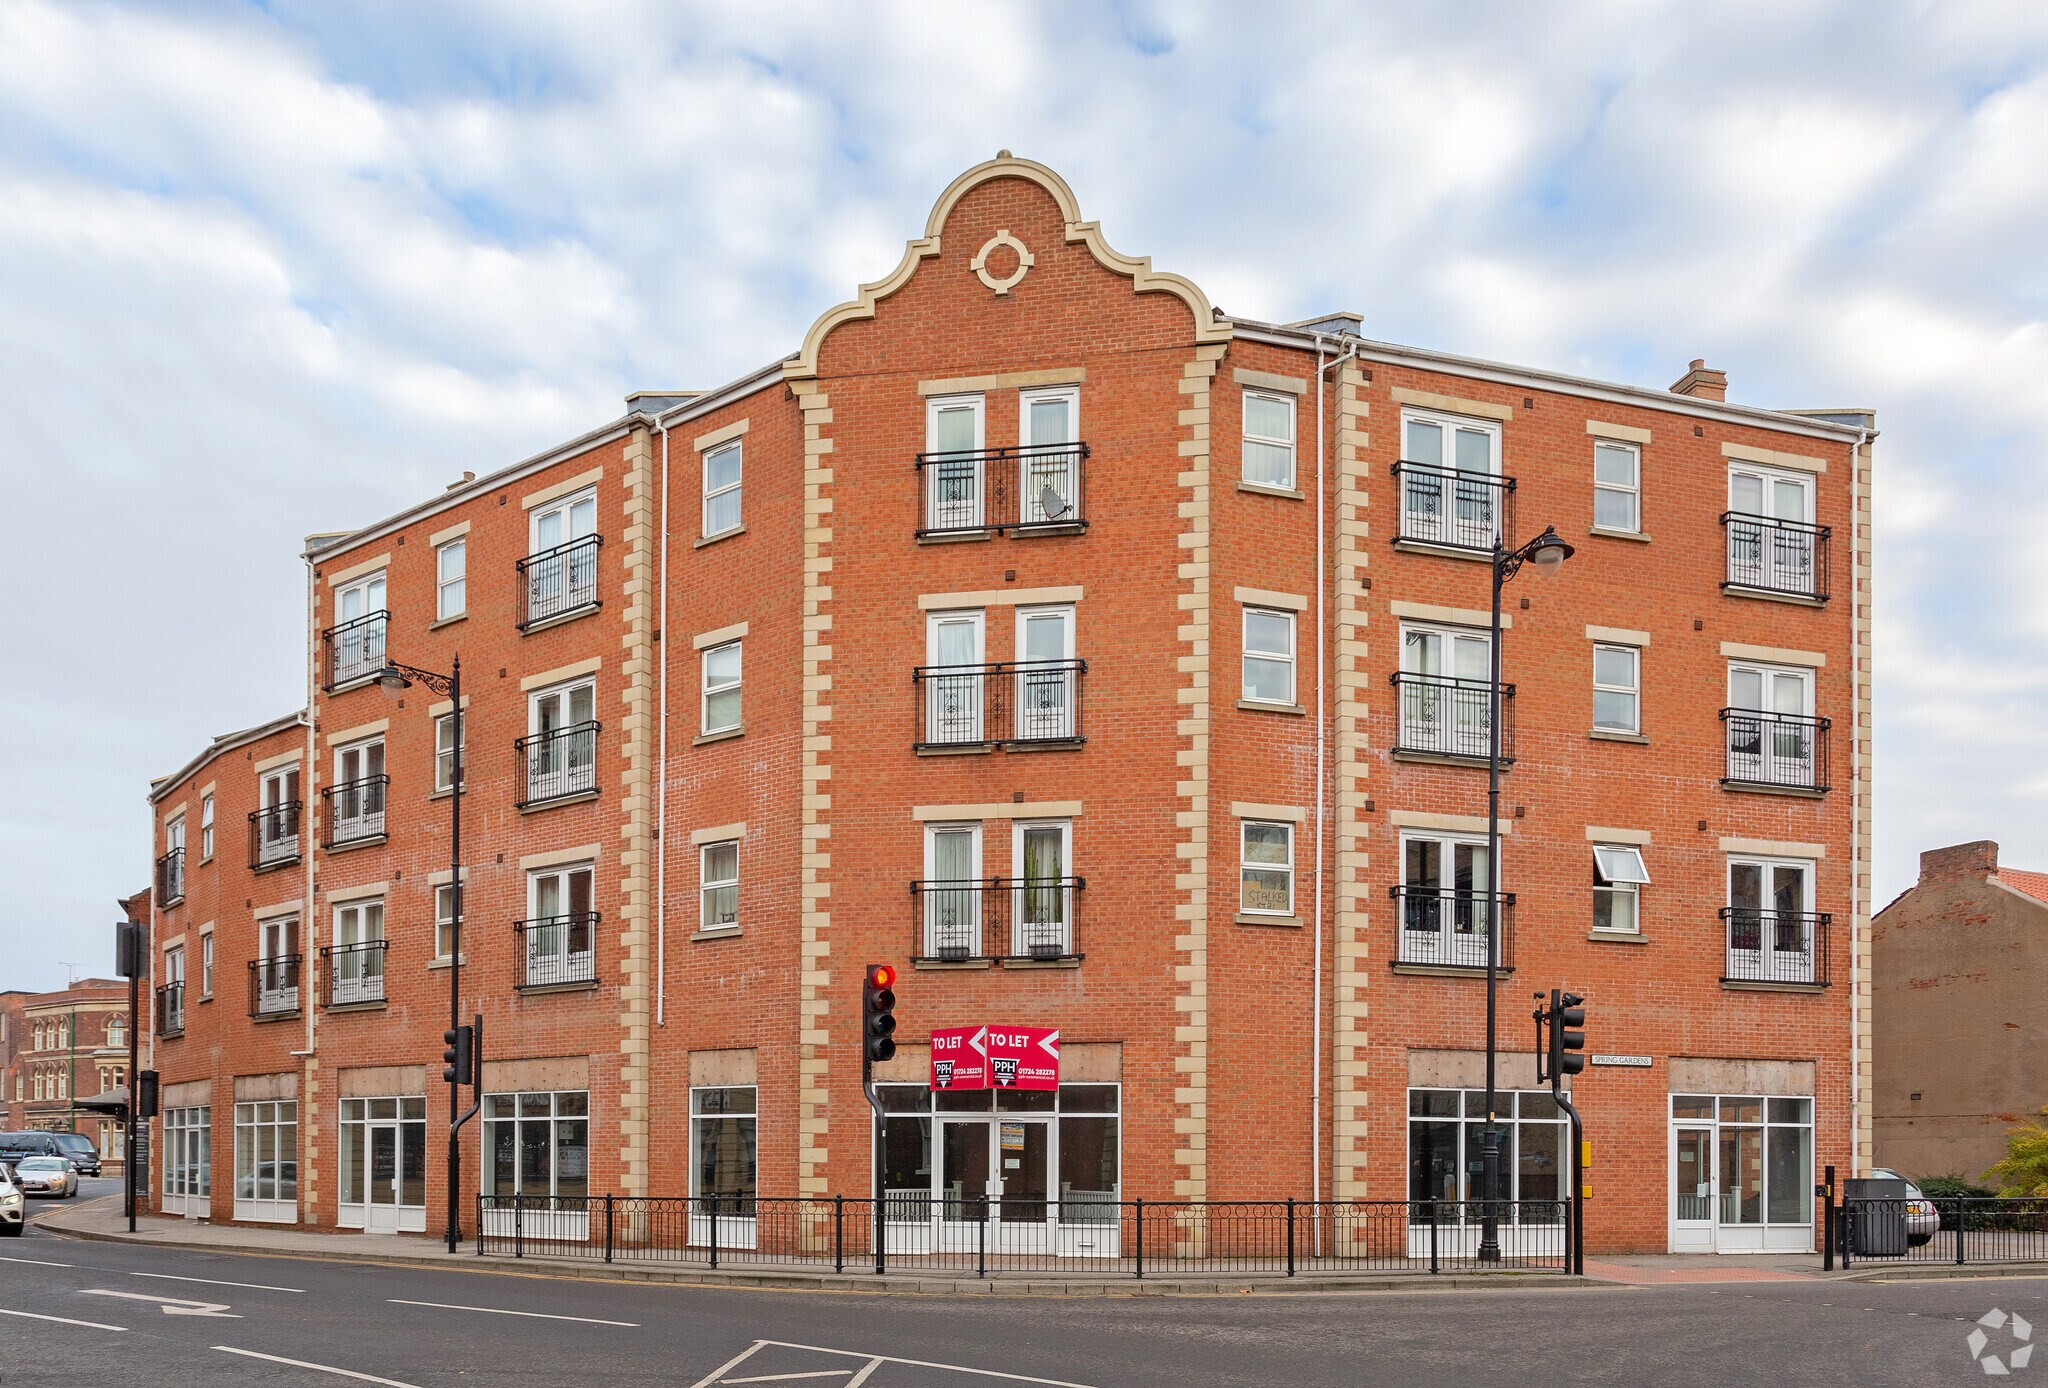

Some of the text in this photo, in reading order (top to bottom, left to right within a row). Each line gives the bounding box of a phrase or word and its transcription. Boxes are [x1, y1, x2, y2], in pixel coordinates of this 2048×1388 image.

[1248, 889, 1287, 903] STALKED
[933, 1036, 962, 1049] TO LET
[989, 1033, 1029, 1047] TO LET
[936, 1064, 952, 1075] PPH
[994, 1061, 1016, 1073] PPH
